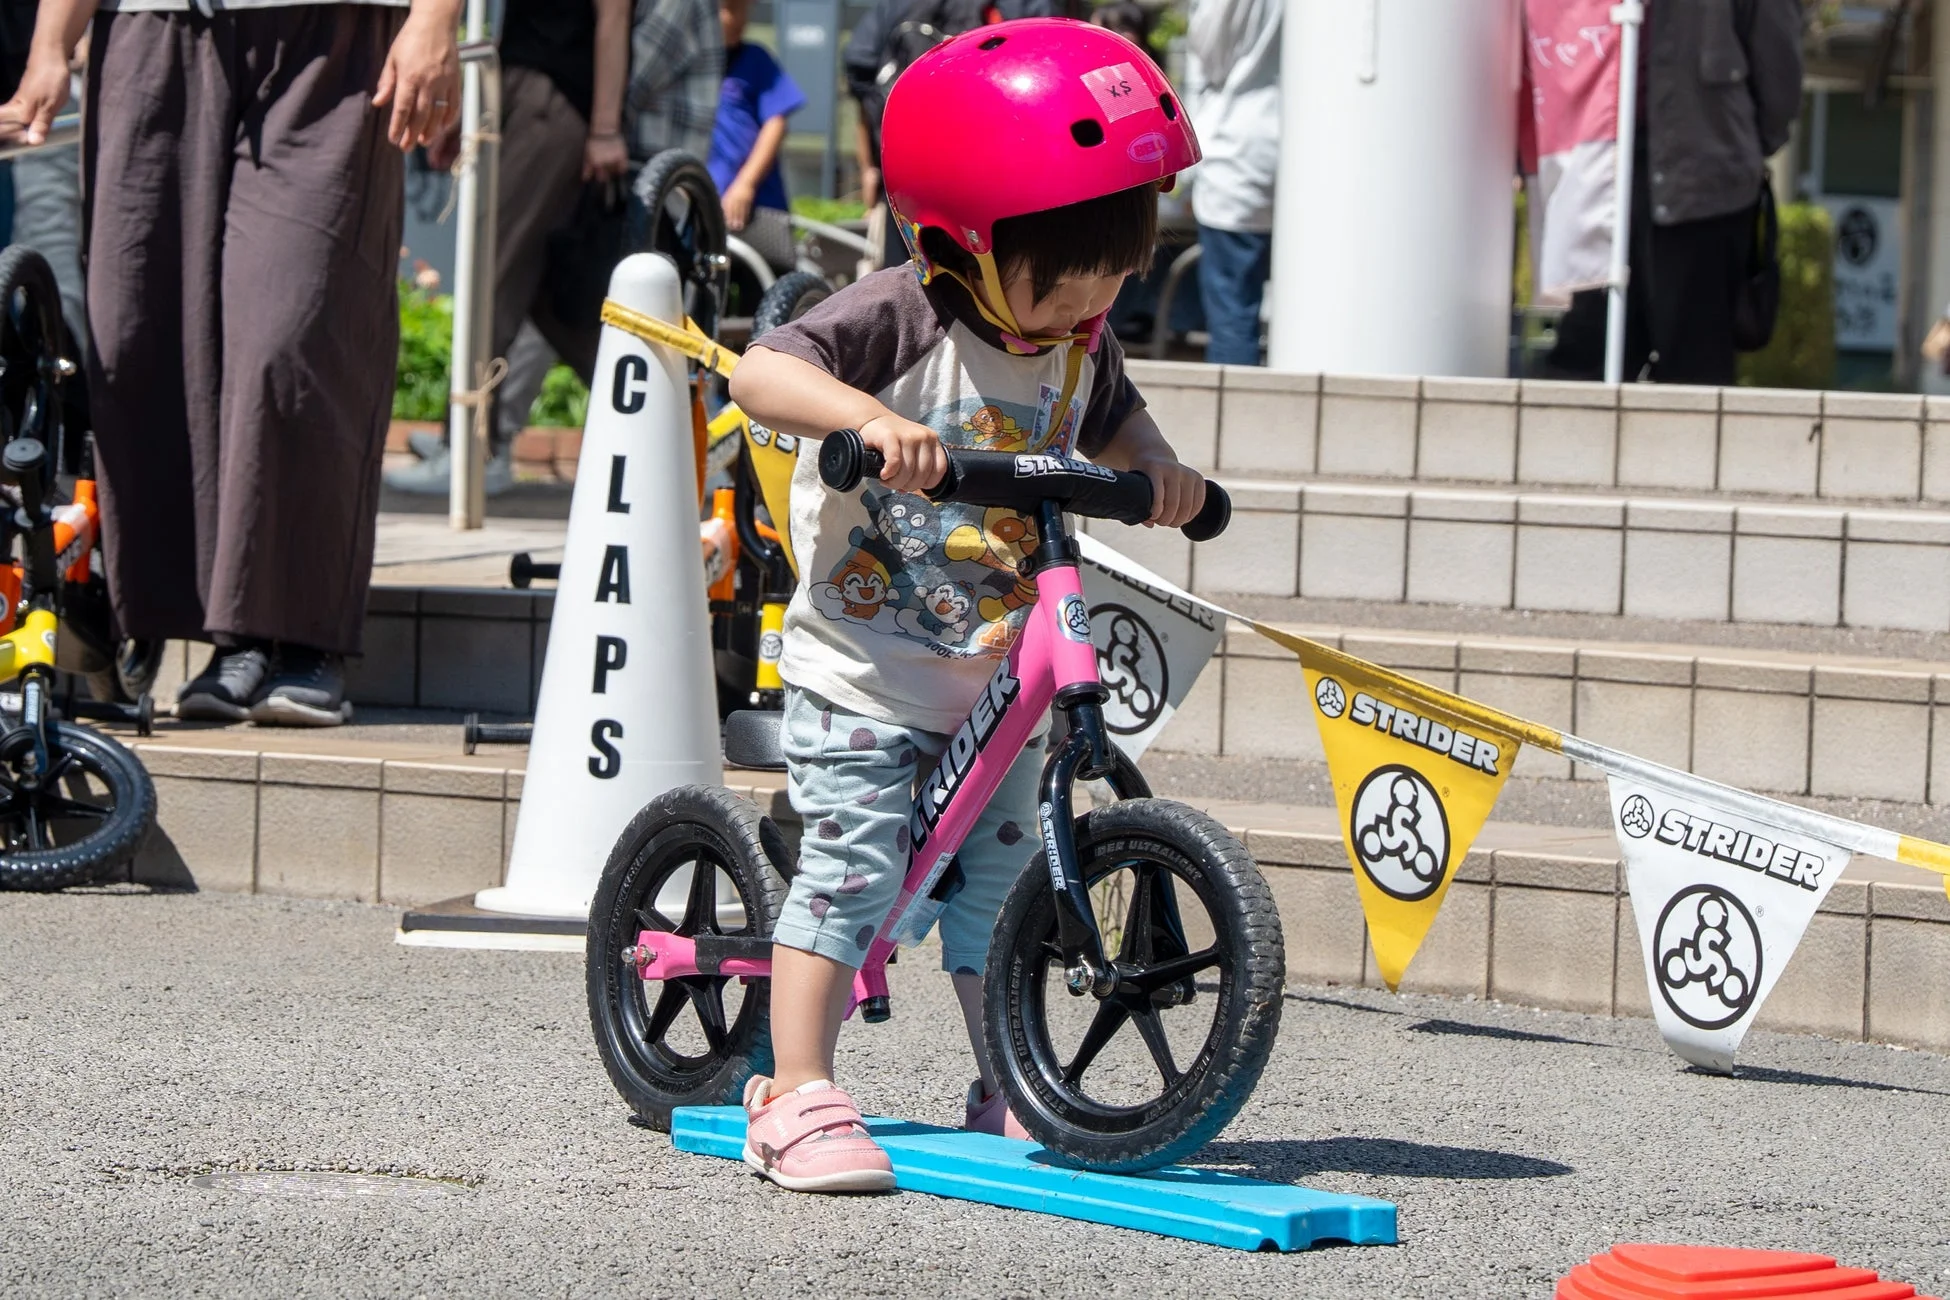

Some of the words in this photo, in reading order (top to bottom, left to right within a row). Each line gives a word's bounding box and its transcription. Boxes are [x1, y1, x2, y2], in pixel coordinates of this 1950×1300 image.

[1106, 80, 1132, 97] XS
[1133, 139, 1165, 158] BELL
[1015, 455, 1117, 482] STRIDER
[588, 354, 648, 780] CLAPS
[909, 655, 1021, 858] TRIDER
[1349, 692, 1500, 777] STRIDER
[1042, 818, 1067, 891] STRIDER
[1654, 809, 1825, 892] STRIDER
